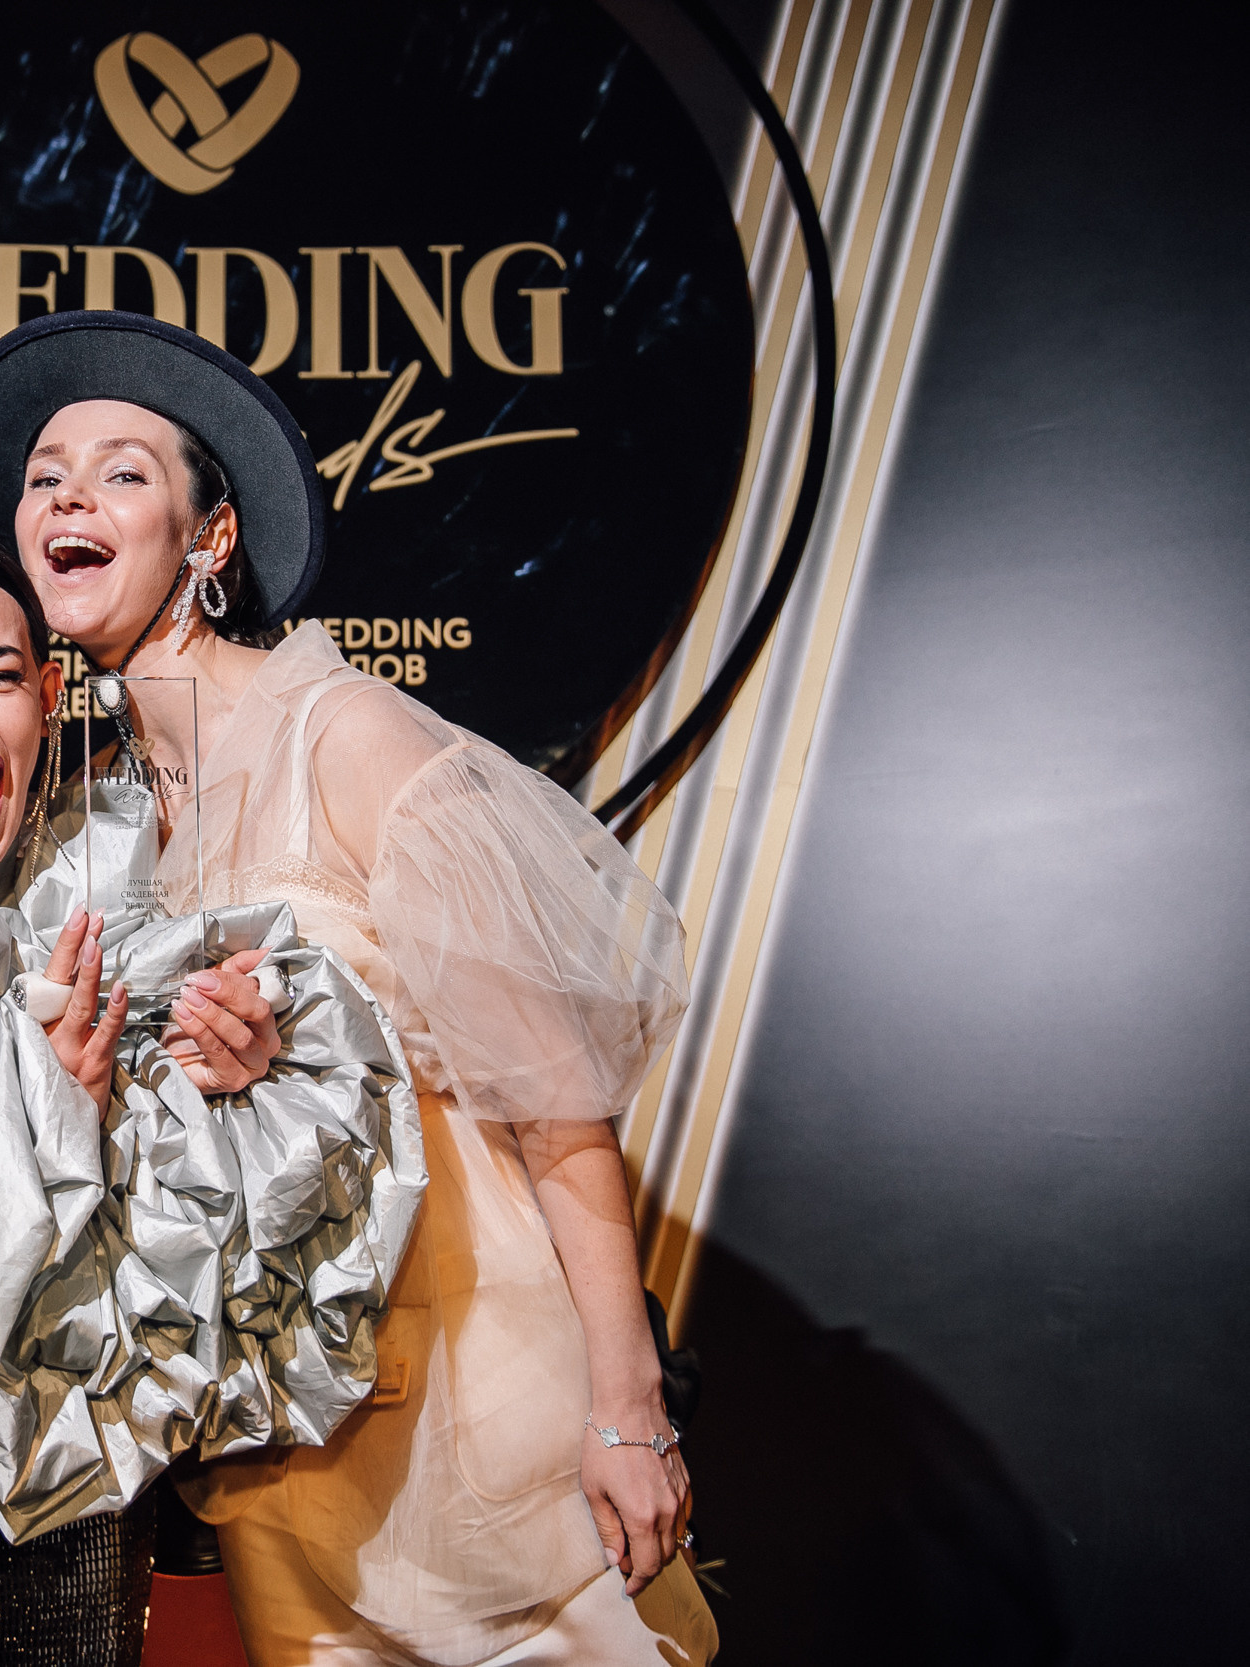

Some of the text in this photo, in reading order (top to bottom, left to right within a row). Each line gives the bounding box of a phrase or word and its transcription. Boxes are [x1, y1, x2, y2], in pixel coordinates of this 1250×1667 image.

[283, 617, 472, 649] EDDING
[95, 766, 188, 785] WEDDING
[125, 902, 165, 910] ВЕДУЩАЯ
